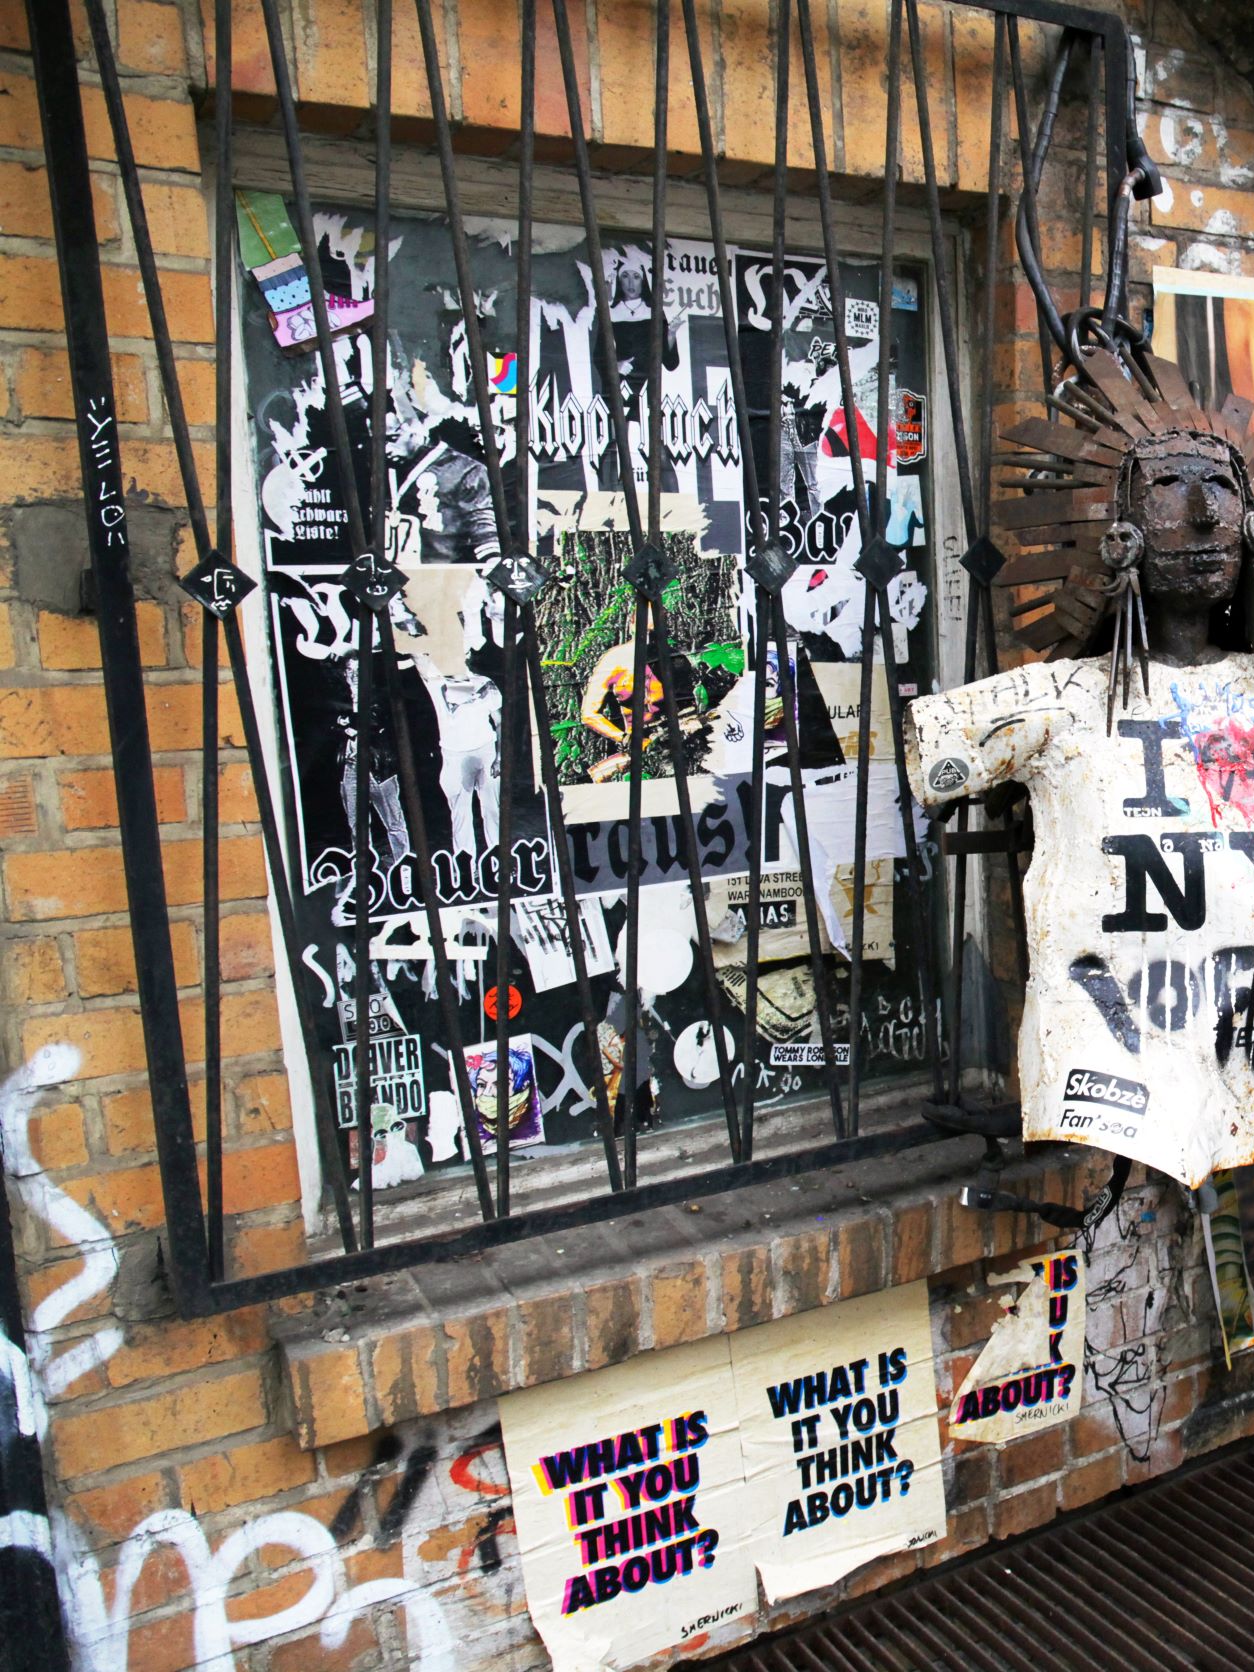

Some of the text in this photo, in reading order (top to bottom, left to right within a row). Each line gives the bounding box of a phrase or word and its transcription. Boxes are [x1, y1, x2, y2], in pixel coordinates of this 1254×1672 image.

[853, 313, 872, 324] MLM
[1117, 719, 1190, 817] I
[774, 1046, 806, 1054] TOMMY
[774, 1054, 804, 1062] WEARS
[1044, 1254, 1078, 1292] IS
[767, 1346, 908, 1418] WHAT IS
[955, 1363, 1076, 1427] ABOUT?
[533, 1409, 709, 1496] WHAT IS
[790, 1388, 901, 1454] IT YOU
[565, 1452, 700, 1531] IT YOU
[796, 1428, 900, 1491] THINK
[575, 1494, 701, 1569] THINK
[782, 1458, 915, 1537] ABOUT?
[560, 1528, 719, 1618] ABOUT?
